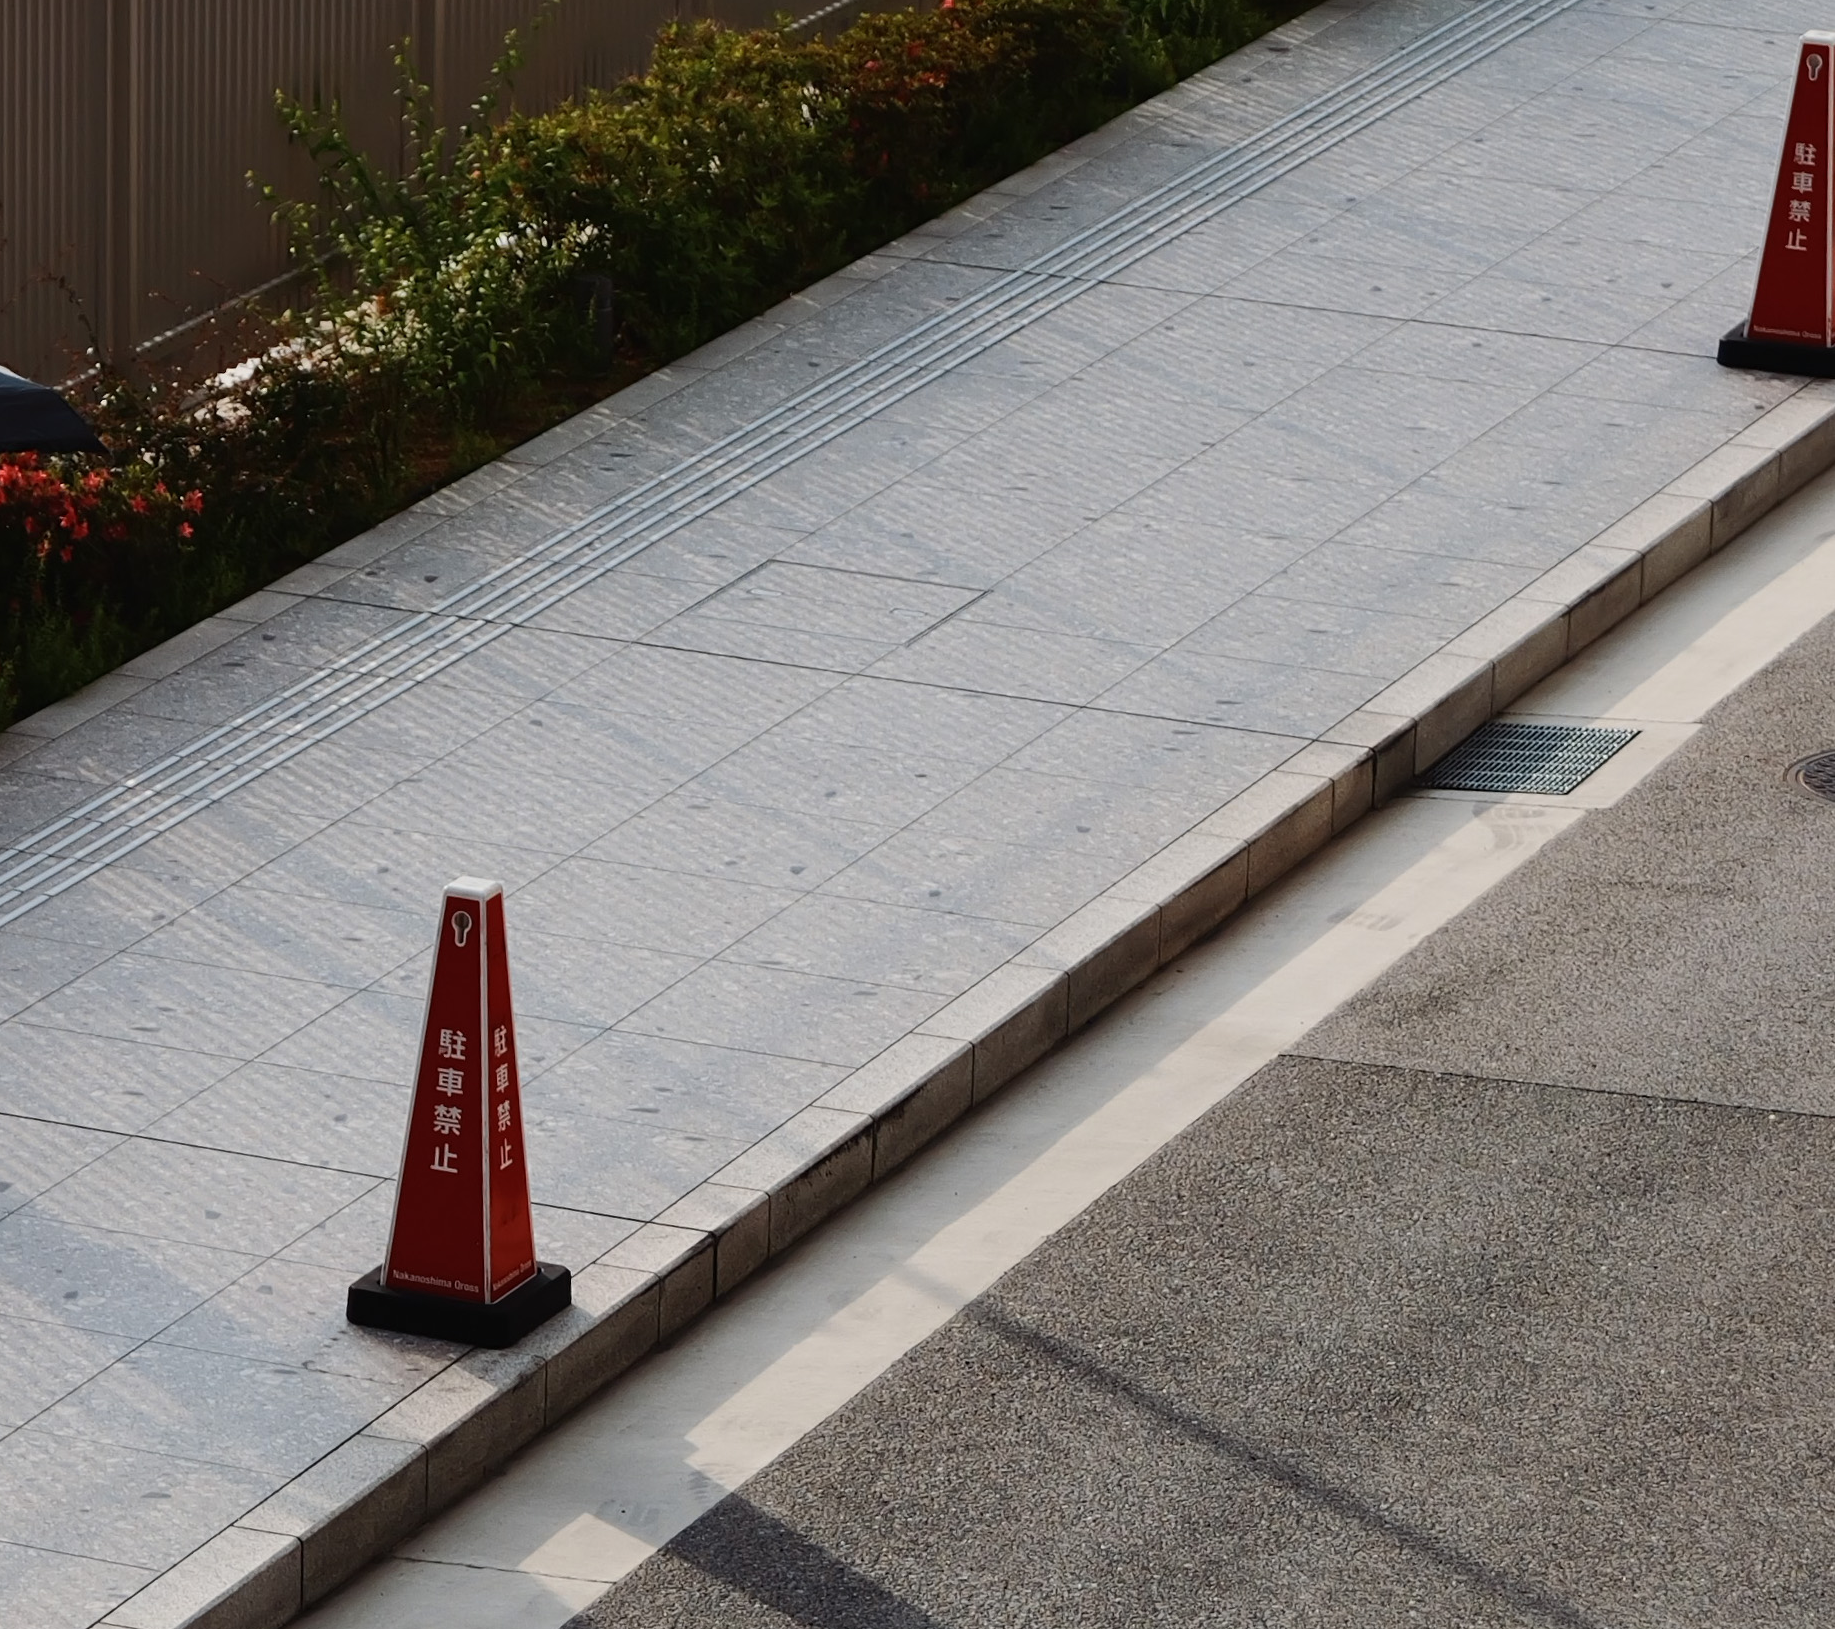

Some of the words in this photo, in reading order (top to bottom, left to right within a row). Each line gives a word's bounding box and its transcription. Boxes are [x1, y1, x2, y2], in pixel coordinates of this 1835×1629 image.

[1785, 142, 1817, 251] 駐車禁止
[430, 1028, 467, 1174] 駐車禁止
[494, 1025, 513, 1171] 駐車禁止
[392, 1269, 452, 1288] Nakanoshima
